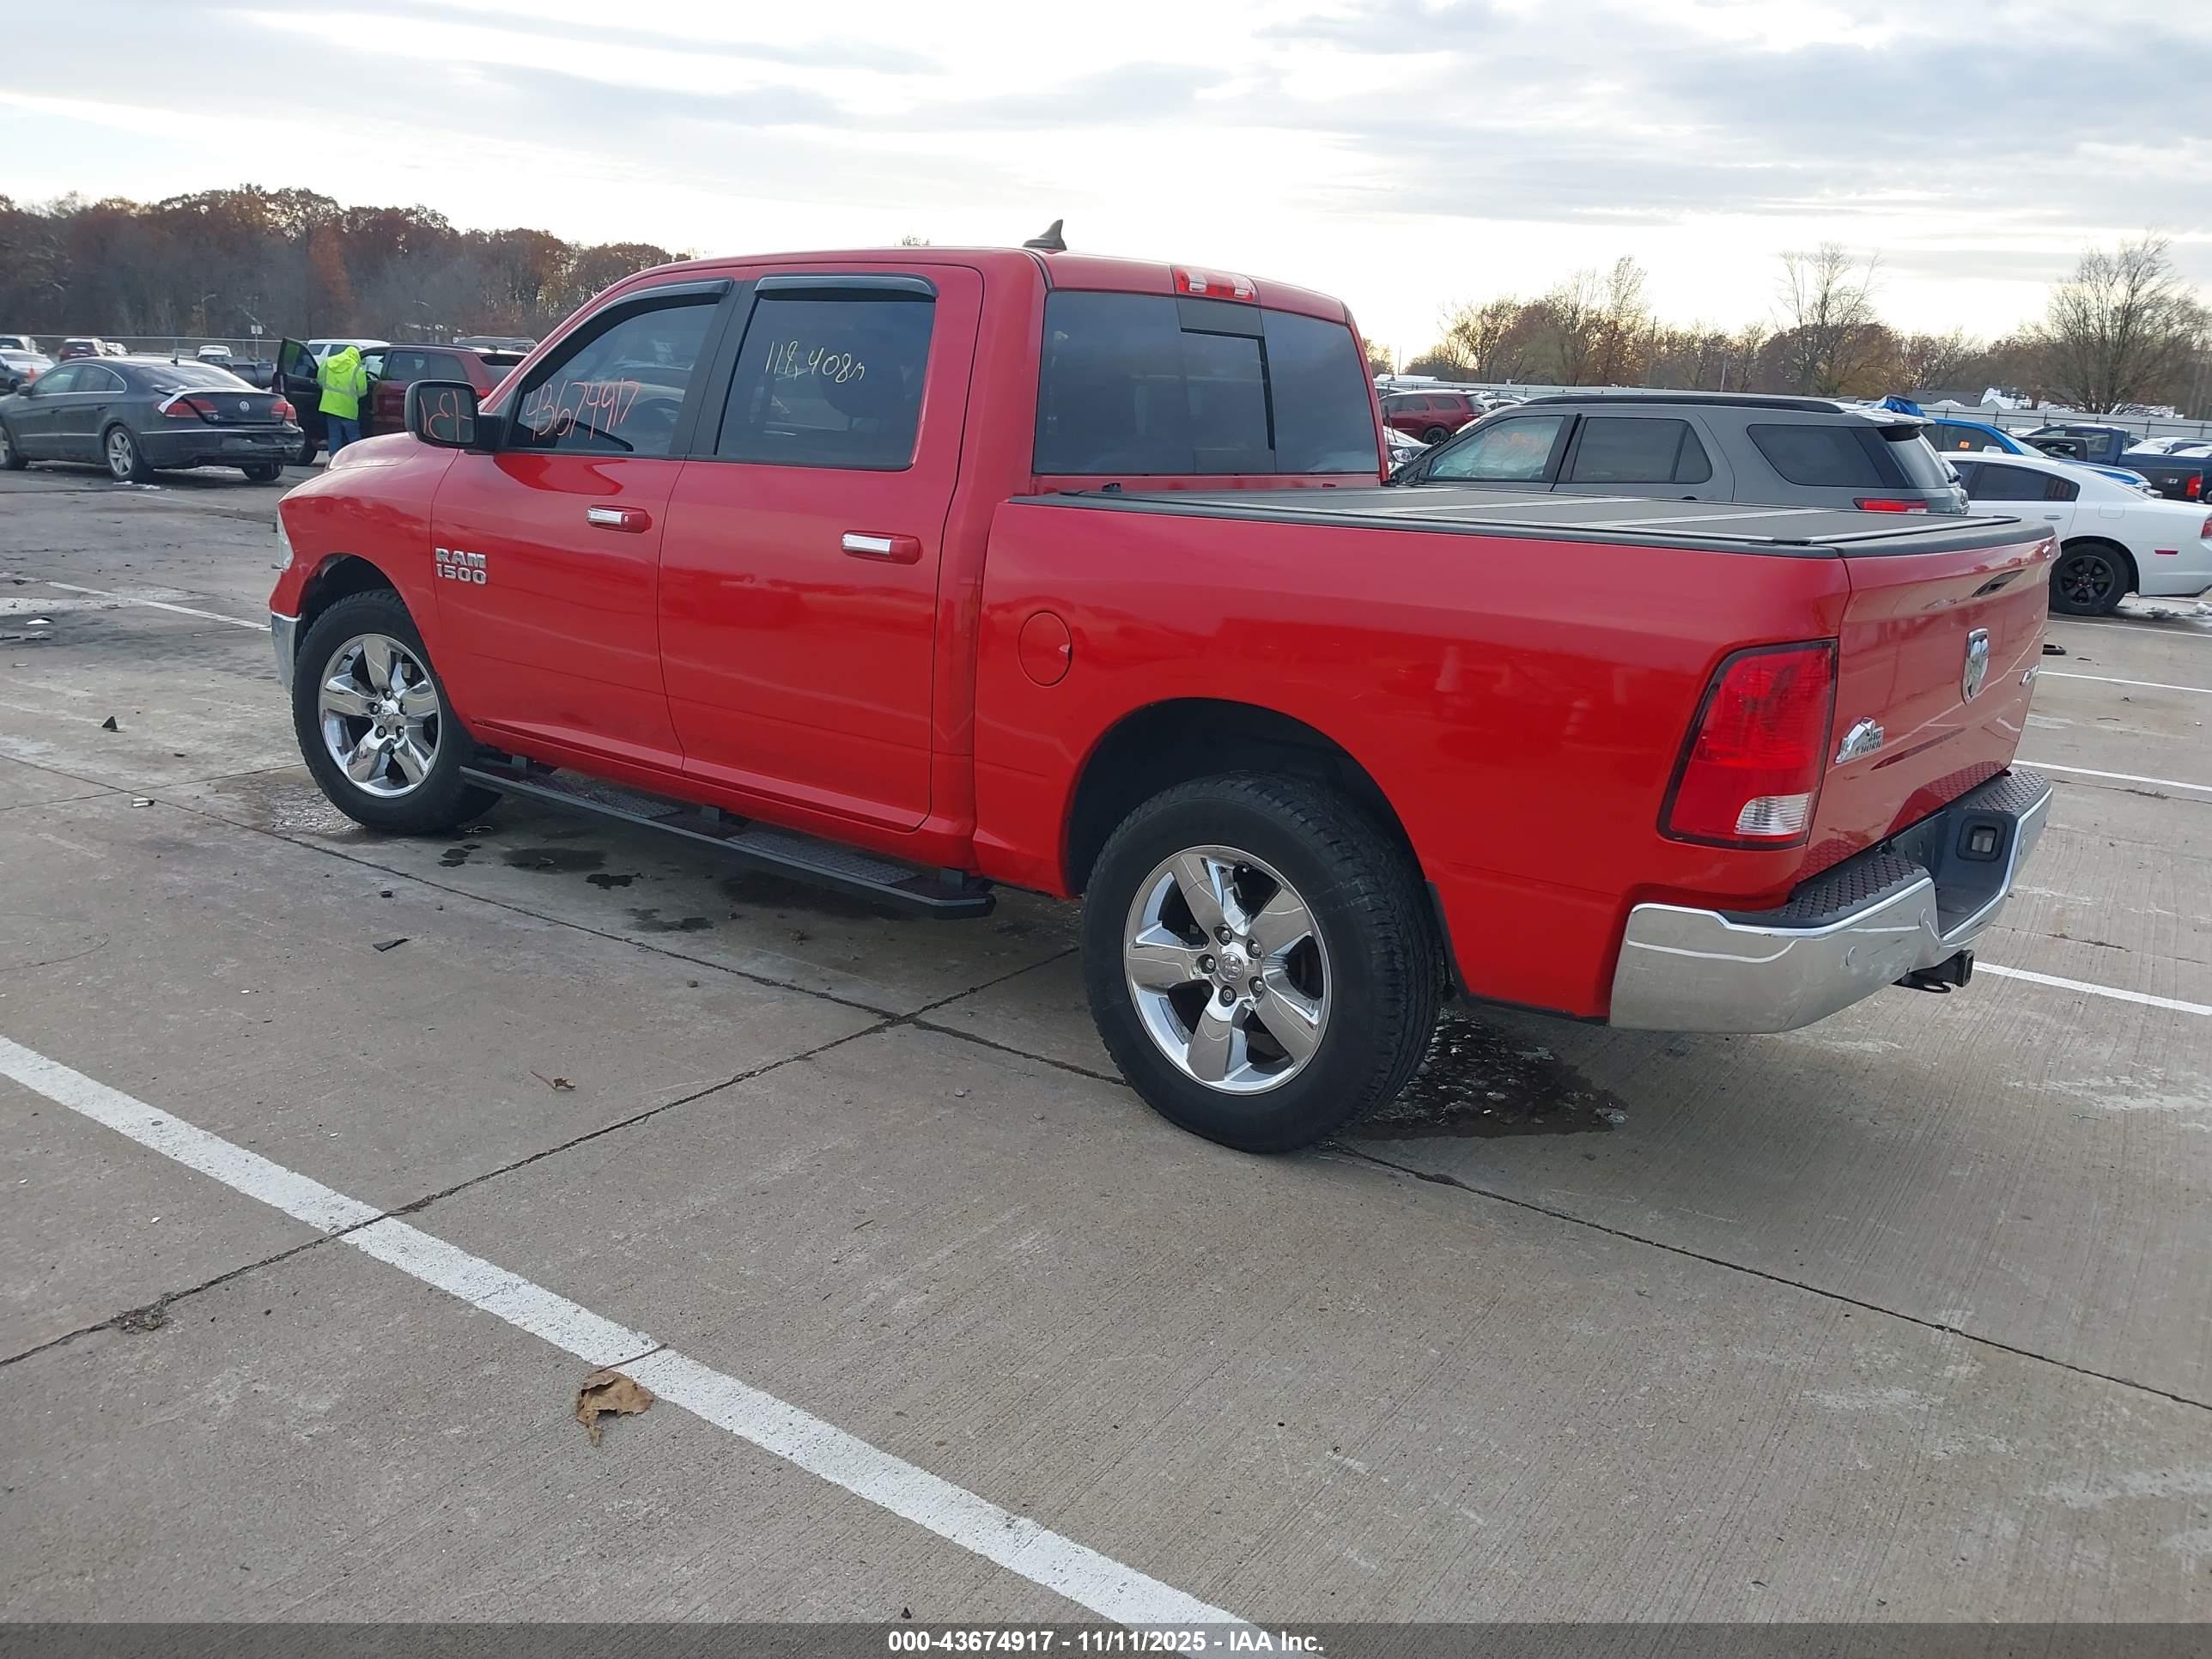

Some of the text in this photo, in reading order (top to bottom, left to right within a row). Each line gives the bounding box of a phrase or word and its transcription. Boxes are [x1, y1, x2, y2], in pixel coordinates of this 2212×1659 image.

[526, 378, 640, 441] 43674917
[434, 547, 487, 568] RAM
[435, 562, 487, 585] 1500
